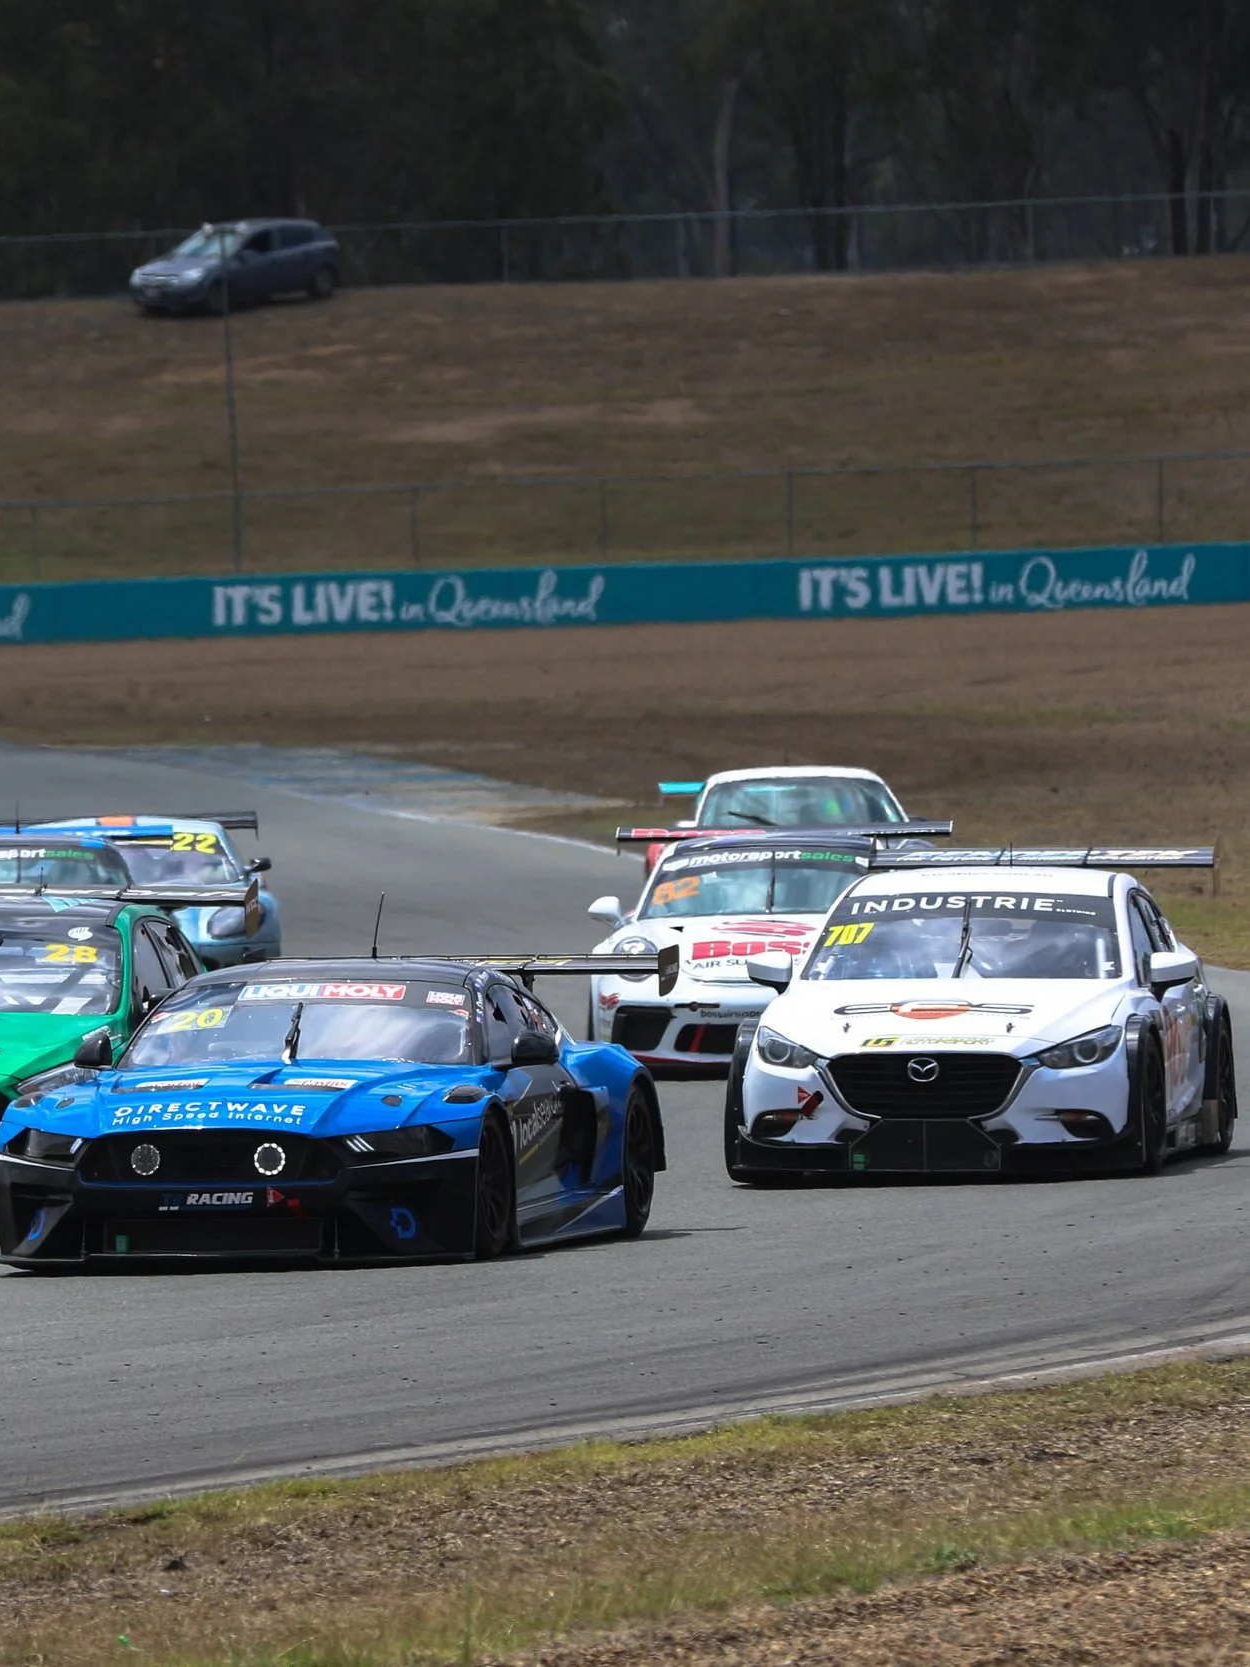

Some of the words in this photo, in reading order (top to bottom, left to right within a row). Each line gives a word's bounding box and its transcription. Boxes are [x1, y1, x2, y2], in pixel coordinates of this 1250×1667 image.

[798, 567, 869, 611] IT'S
[878, 562, 983, 608] LIVE!
[989, 582, 1014, 602] in
[1019, 549, 1195, 607] Queensland
[213, 585, 282, 626] IT'S
[292, 581, 394, 625] LIVE!
[400, 602, 426, 622] in
[429, 571, 604, 626] Queensland
[173, 832, 217, 854] 22
[689, 850, 855, 867] motorsportsales
[652, 875, 701, 906] 82
[851, 896, 1056, 915] INDUSTRIE
[823, 922, 875, 947] 707
[45, 944, 98, 963] 28
[693, 960, 721, 970] AIR
[243, 984, 319, 999] LIQUI
[322, 984, 404, 998] MOLY
[170, 1007, 224, 1031] 20
[112, 1115, 152, 1126] High
[162, 1111, 218, 1122] Speed
[228, 1111, 302, 1125] Internet
[114, 1101, 306, 1117] DIRECTWAVE
[186, 1192, 253, 1205] RACING
